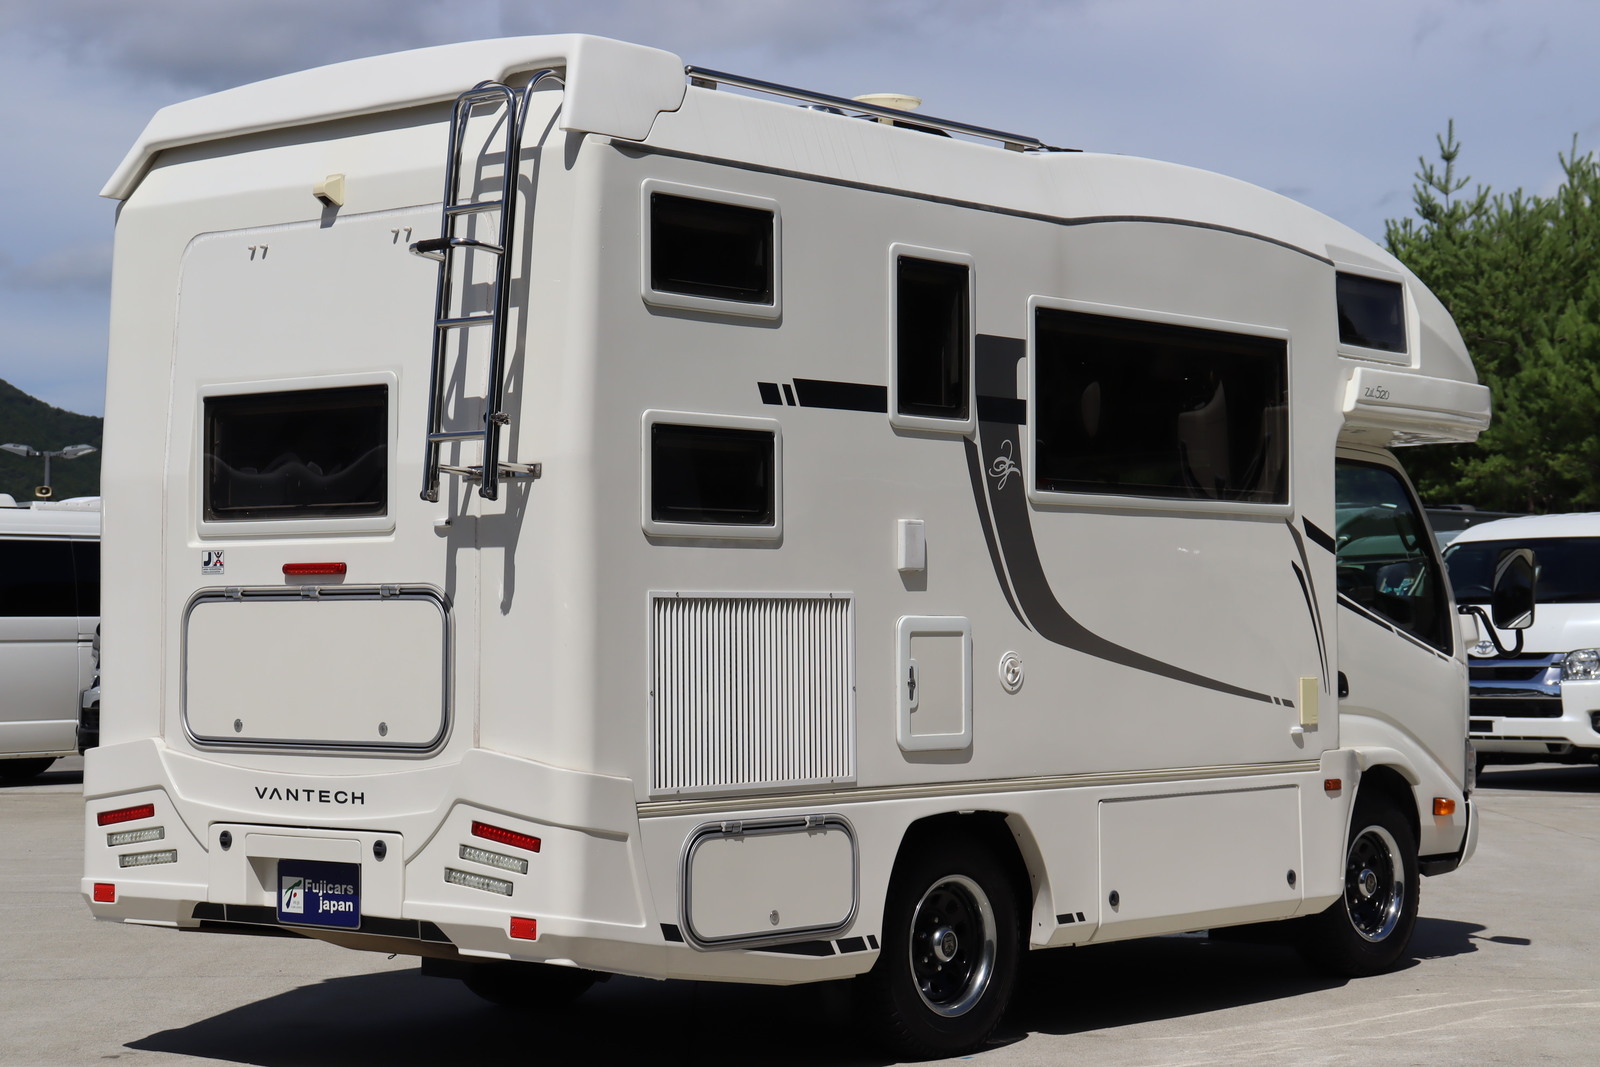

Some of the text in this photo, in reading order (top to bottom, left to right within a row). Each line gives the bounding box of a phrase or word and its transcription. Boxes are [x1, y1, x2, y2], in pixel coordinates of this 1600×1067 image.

[1375, 385, 1390, 400] 520
[254, 786, 365, 805] VANTECH
[305, 879, 354, 896] Fujicars
[318, 896, 354, 914] japan
